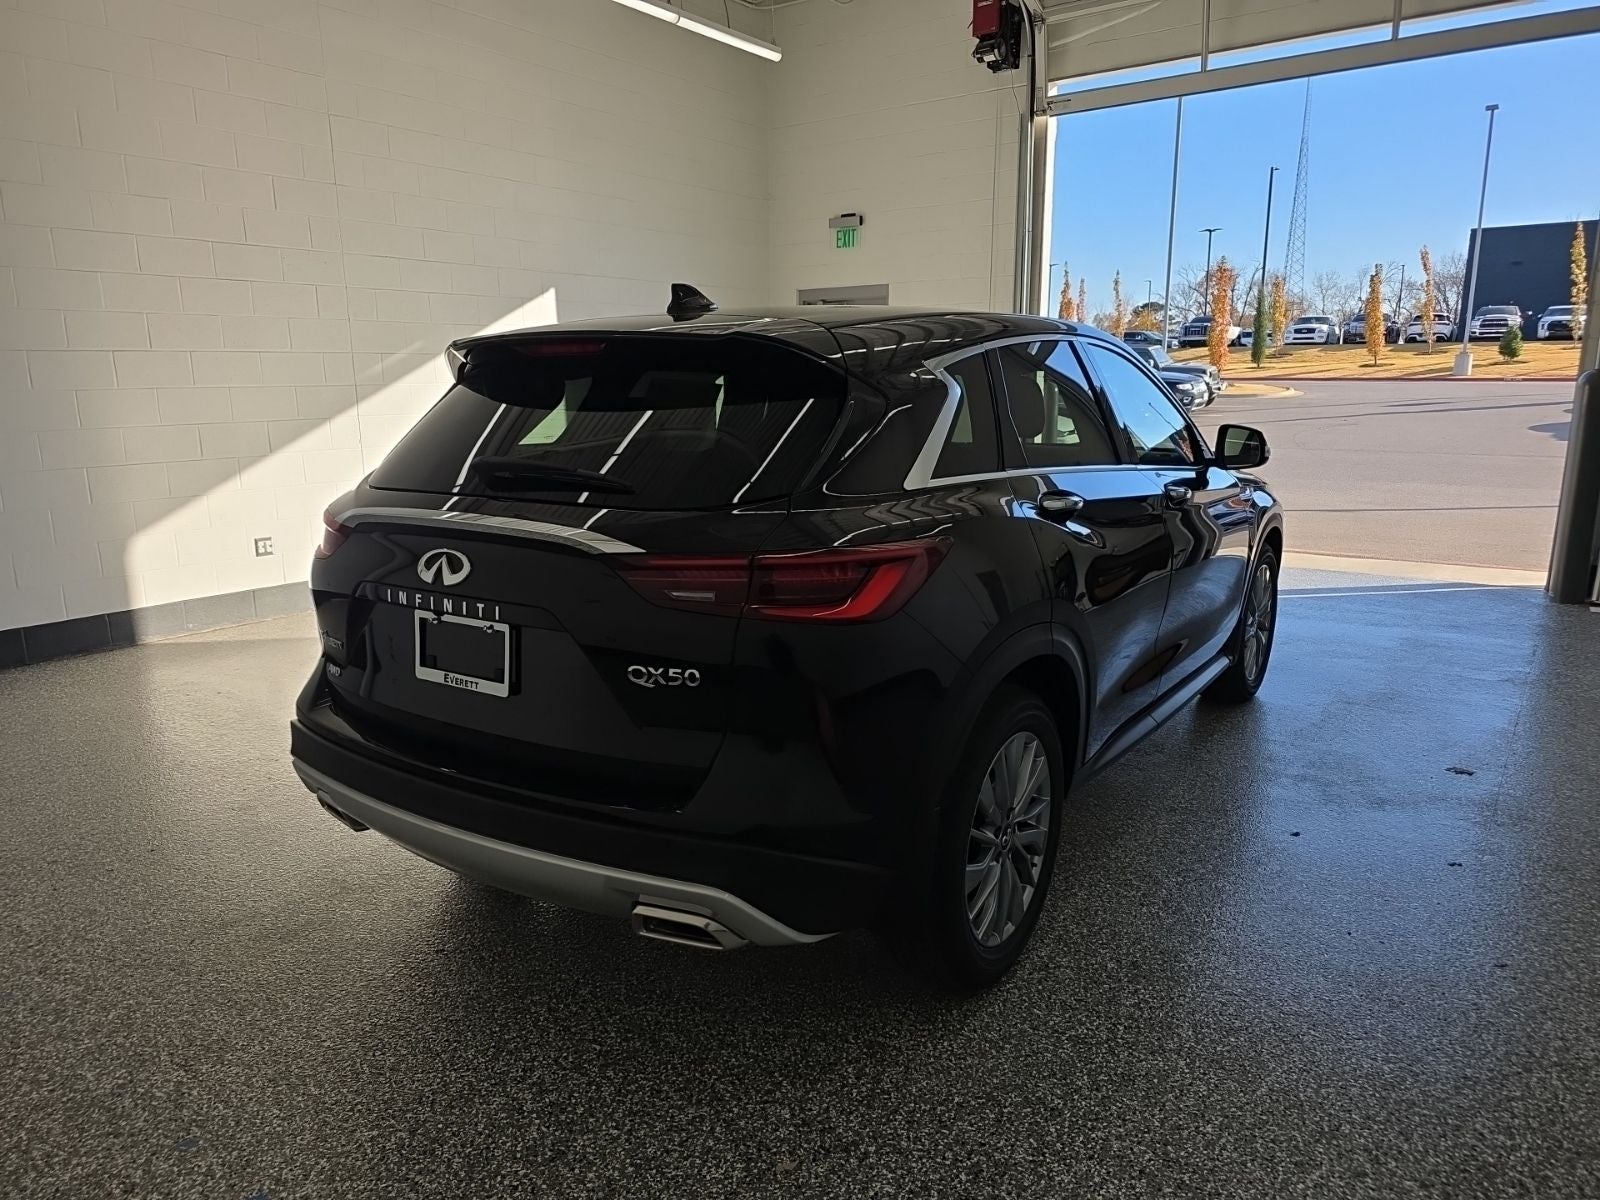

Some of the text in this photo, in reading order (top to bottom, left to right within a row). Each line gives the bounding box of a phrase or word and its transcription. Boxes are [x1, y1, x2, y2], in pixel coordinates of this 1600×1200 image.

[836, 228, 857, 249] EXIT
[387, 588, 500, 621] INFINITI
[443, 673, 479, 690] EVERETT
[626, 665, 701, 688] QX50
